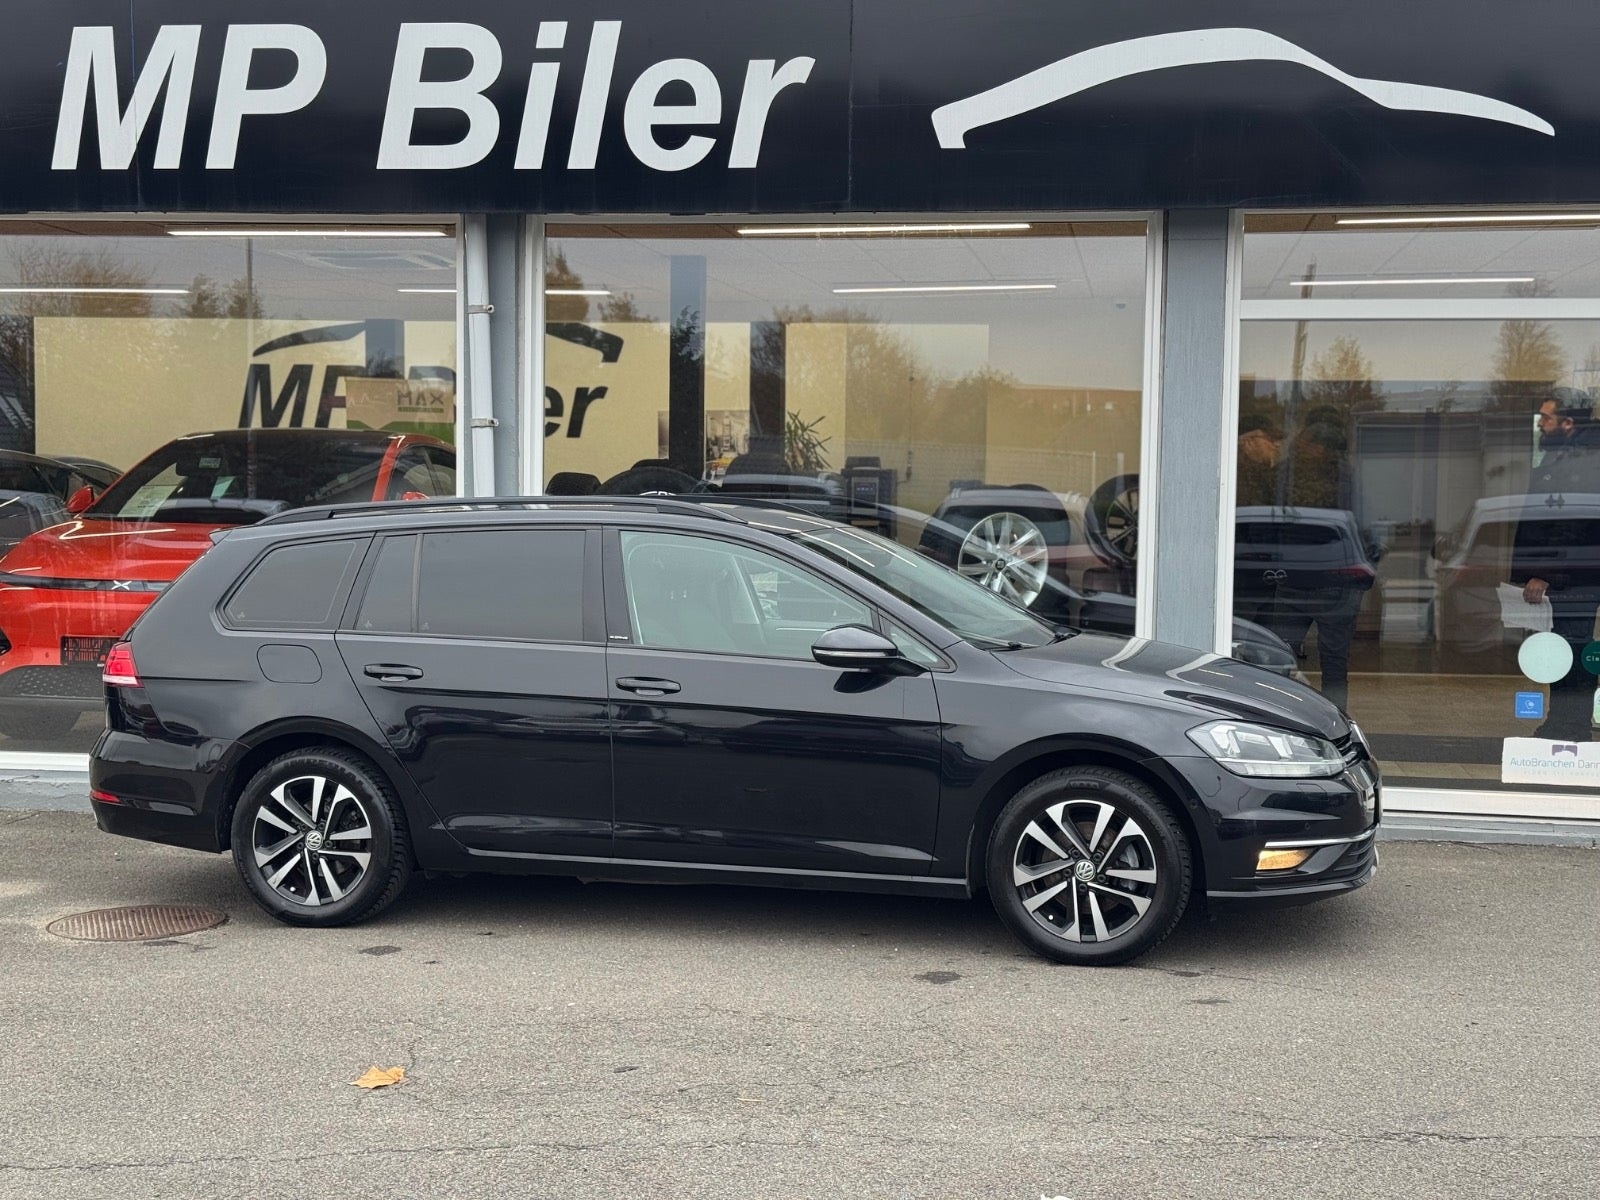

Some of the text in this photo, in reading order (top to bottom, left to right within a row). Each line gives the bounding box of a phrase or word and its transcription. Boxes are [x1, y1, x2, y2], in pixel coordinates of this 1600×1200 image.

[52, 20, 816, 171] MP Biler
[397, 390, 444, 406] MAX
[1510, 757, 1575, 769] AutoBranchen
